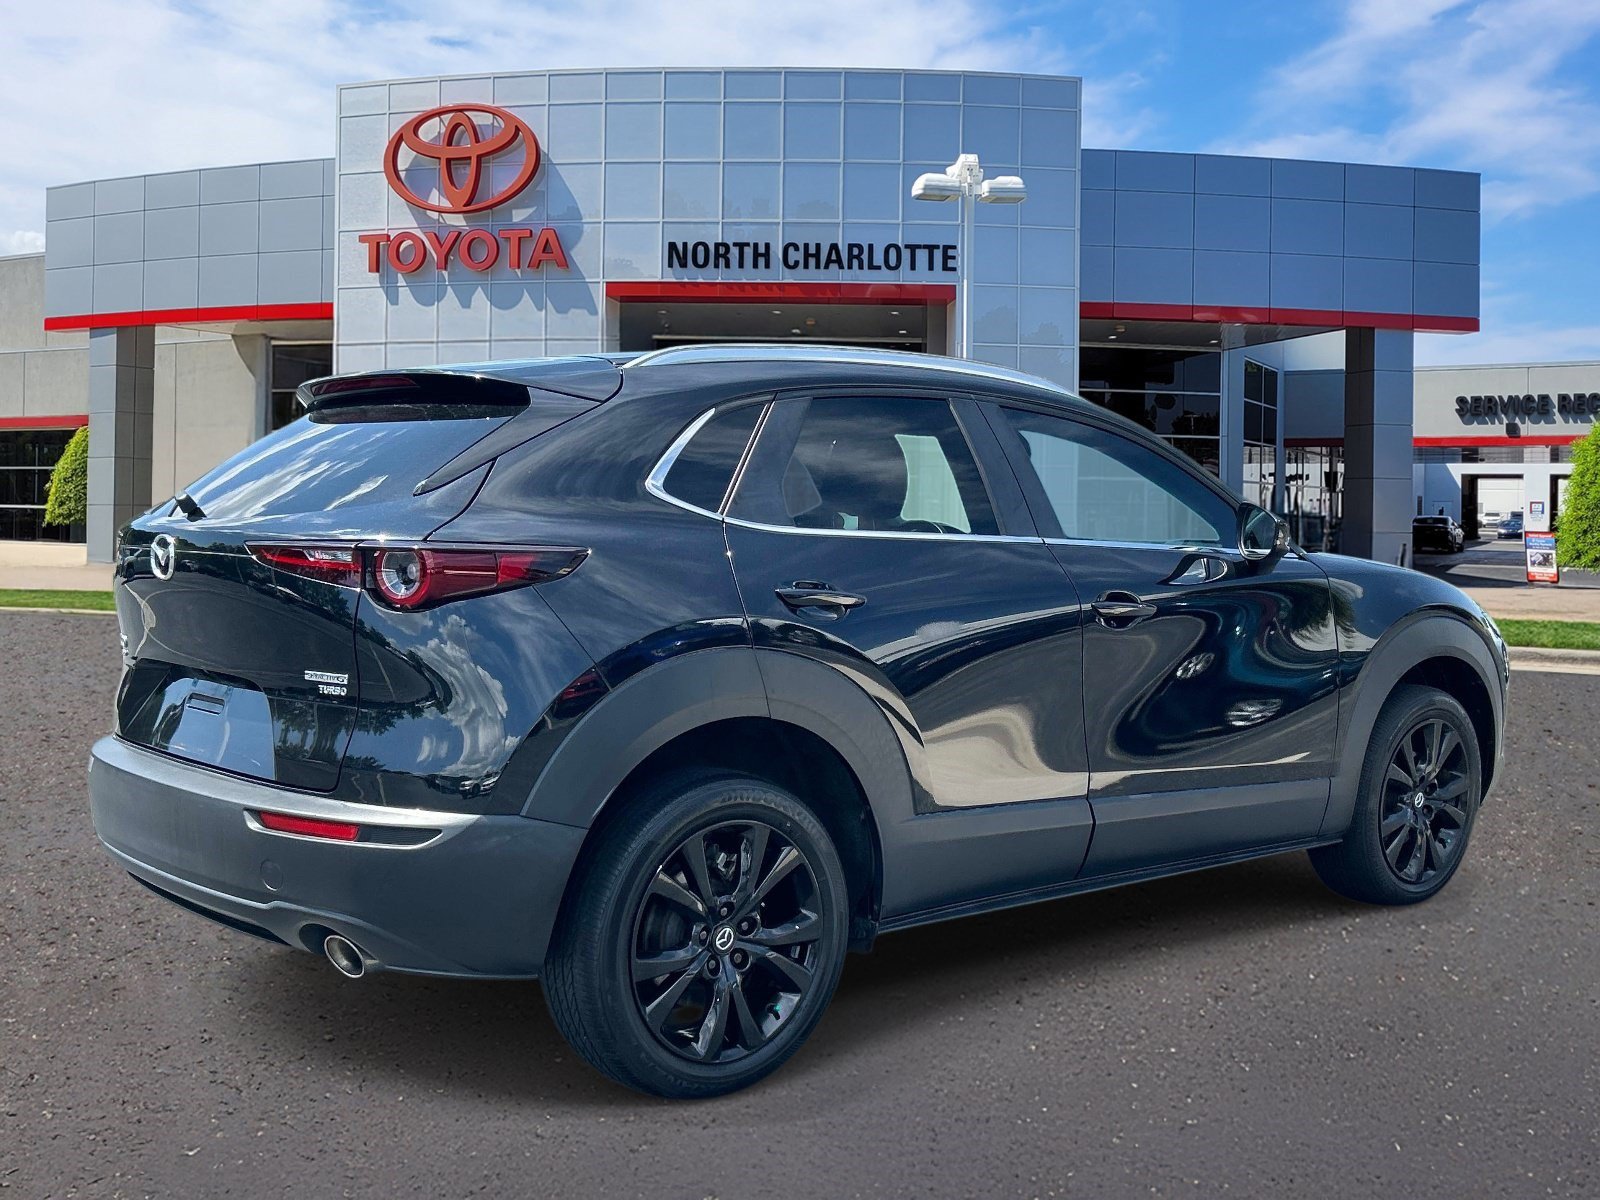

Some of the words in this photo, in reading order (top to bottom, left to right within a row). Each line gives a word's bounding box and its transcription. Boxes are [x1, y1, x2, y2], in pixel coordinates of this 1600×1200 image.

[359, 228, 569, 274] TOYOTA
[667, 241, 771, 269] NORTH
[782, 242, 958, 272] CHARLOTTE
[1455, 393, 1552, 417] SERVICE
[318, 685, 347, 696] TURBO
